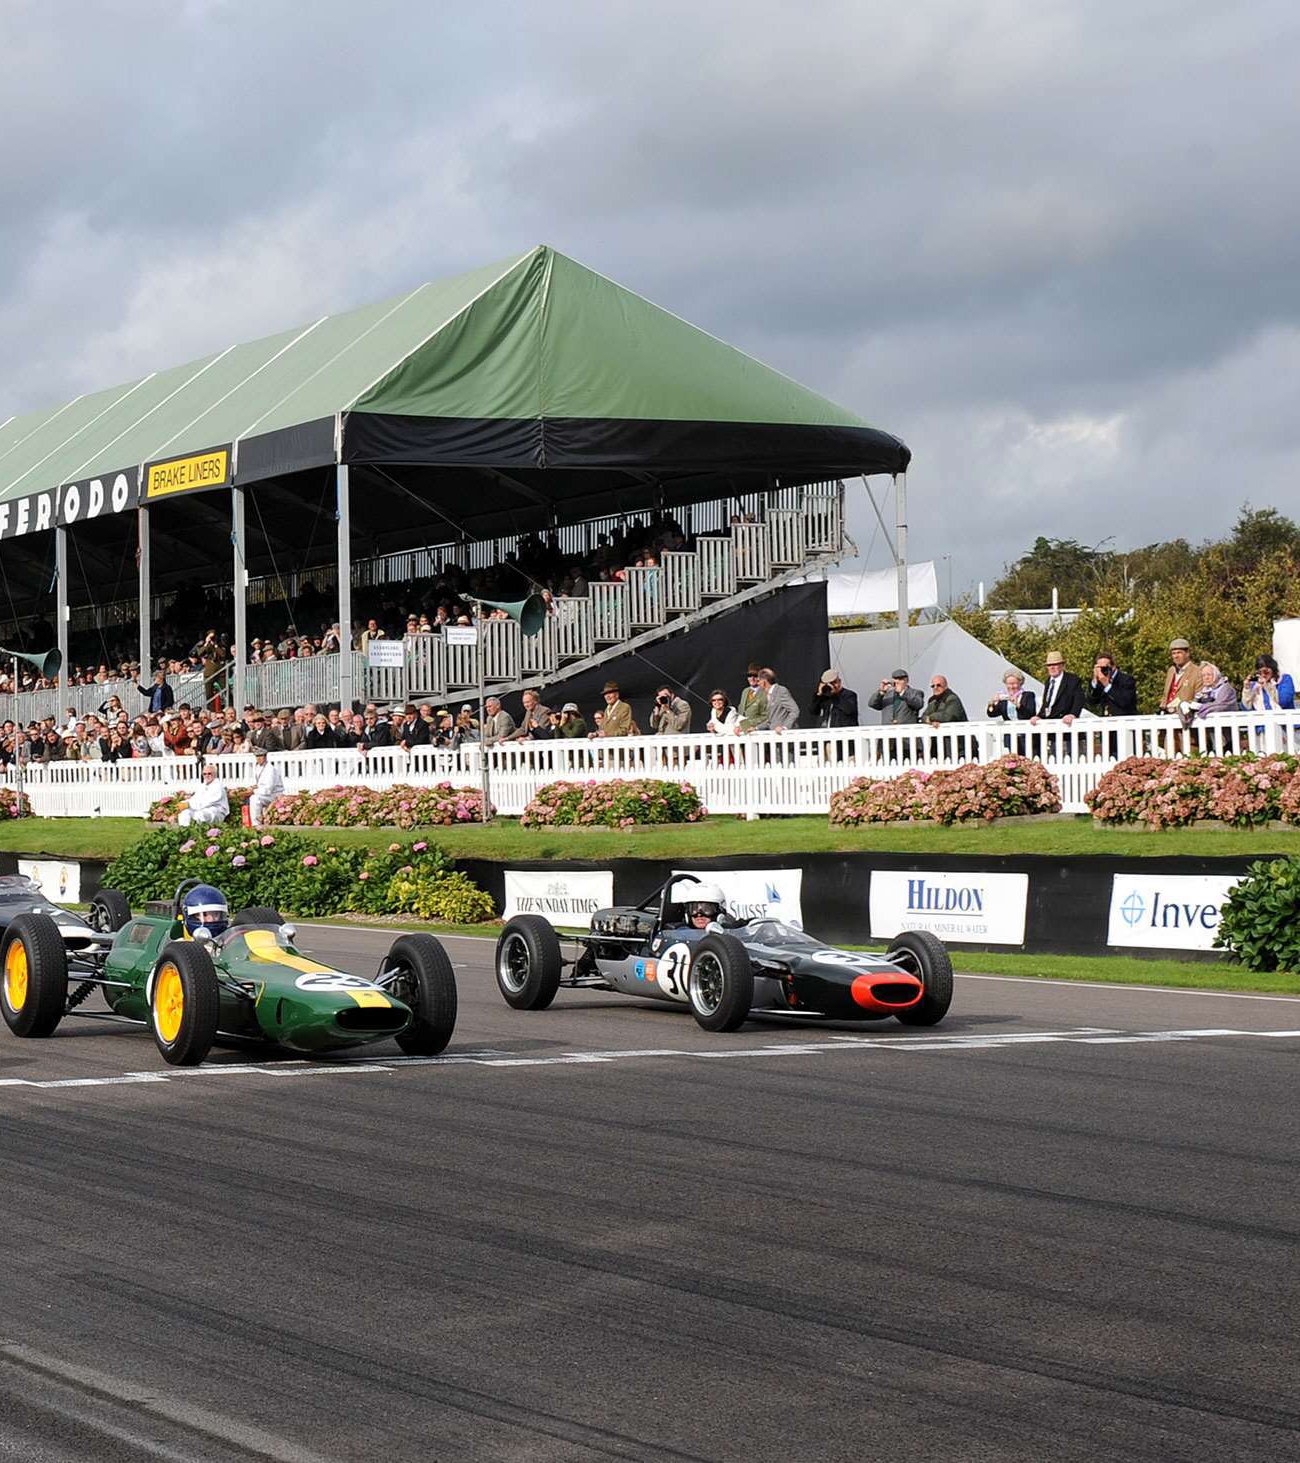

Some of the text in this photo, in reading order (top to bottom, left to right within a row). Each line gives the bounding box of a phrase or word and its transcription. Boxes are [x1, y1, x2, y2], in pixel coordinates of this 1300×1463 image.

[153, 458, 220, 490] BRAKE LINERS
[536, 897, 569, 913] SUNDAY
[570, 898, 599, 914] TIMES
[907, 879, 985, 911] HILDON
